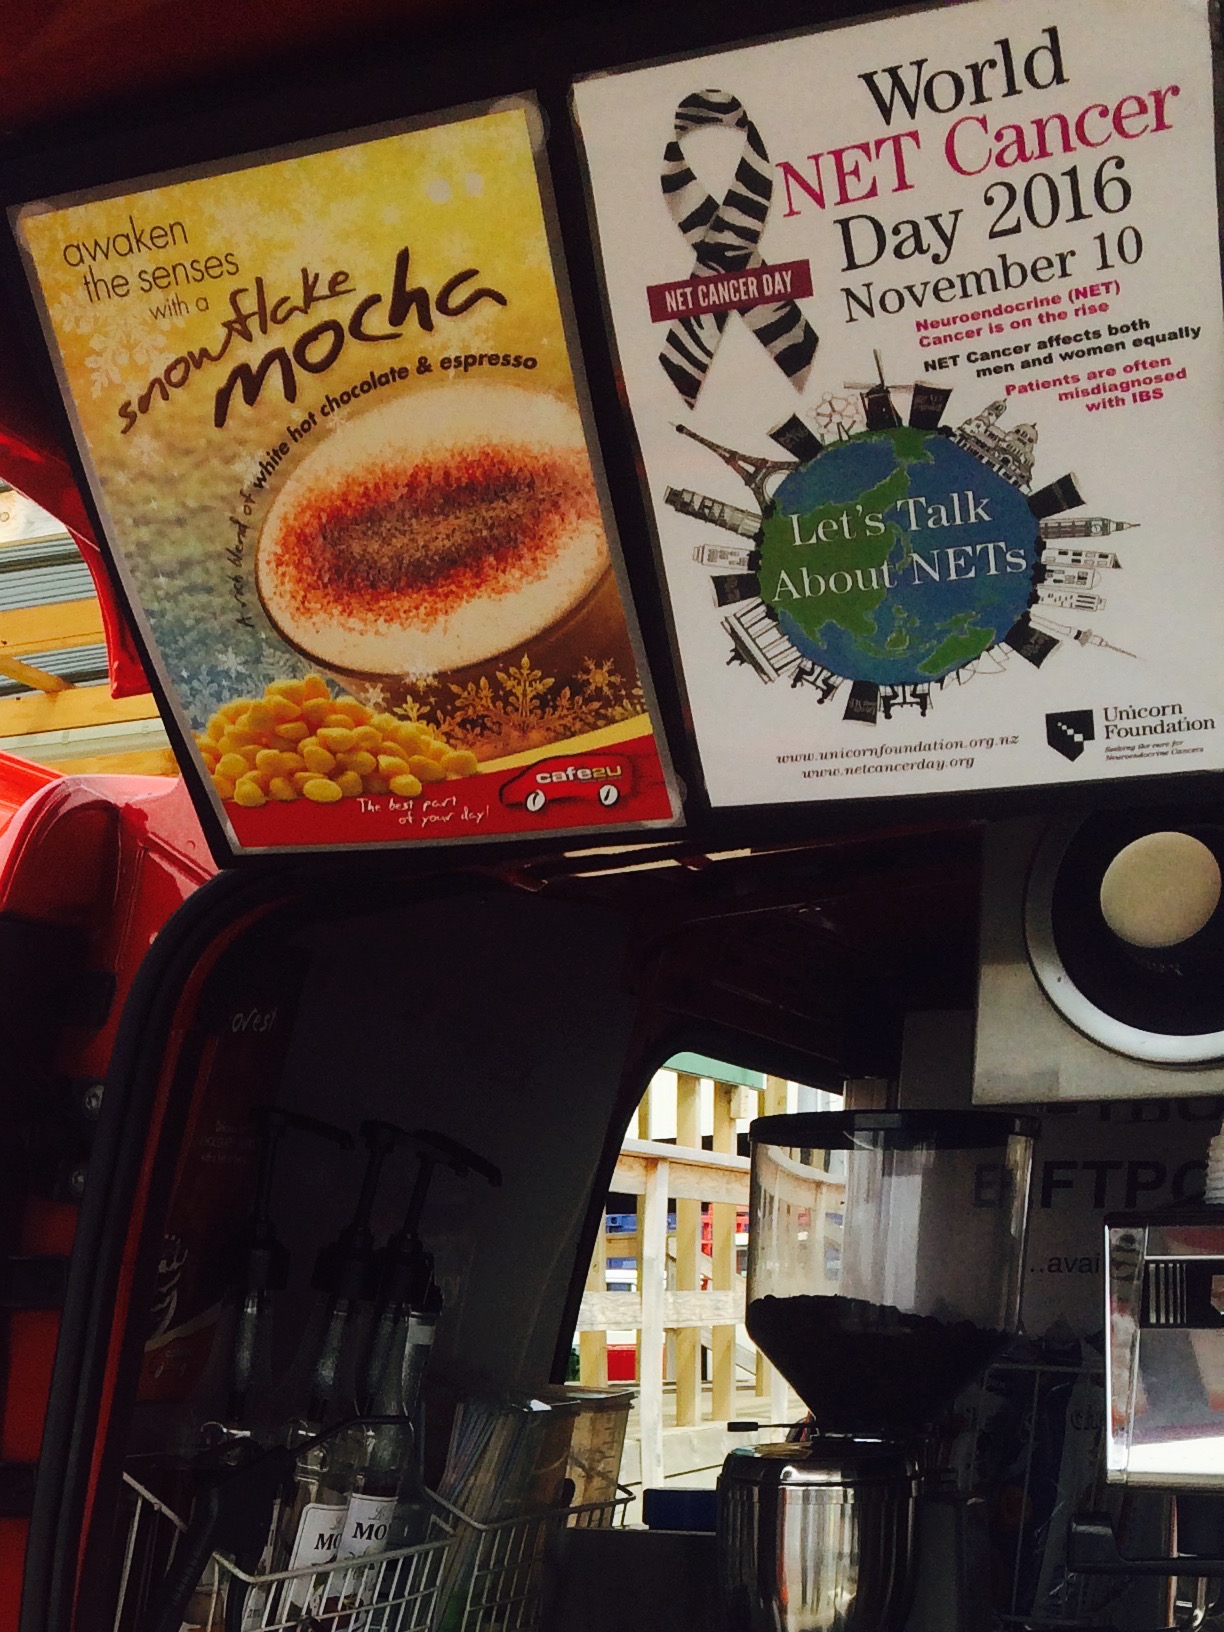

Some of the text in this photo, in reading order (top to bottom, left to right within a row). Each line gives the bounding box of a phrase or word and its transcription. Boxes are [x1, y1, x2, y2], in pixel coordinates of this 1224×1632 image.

[859, 26, 1069, 127] World
[776, 85, 1180, 217] NET Cancer
[834, 155, 1132, 272] Day 2016
[63, 215, 189, 267] awaken
[83, 252, 240, 303] the senses
[664, 270, 794, 314] NET CANCER DAY
[843, 226, 1143, 323] November 10
[148, 293, 210, 321] with a
[915, 279, 1121, 332] Neuroendocrine (NET)
[919, 301, 1110, 348] Cancer is on the rise
[924, 317, 1151, 372] NET Cancer affects both
[976, 326, 1202, 378] men and women equally
[1005, 356, 1172, 396] Patients are often
[1058, 367, 1187, 402] misdiagnosed
[1085, 387, 1164, 413] with IBS
[254, 441, 291, 491] white
[286, 411, 318, 443] hot
[320, 364, 410, 417] chocolate
[416, 356, 433, 375] &
[440, 352, 538, 373] espresso
[789, 491, 993, 547] Let's Talk
[772, 540, 1029, 602] About NETs
[1103, 703, 1183, 722] Unicorn
[1104, 716, 1216, 740] Foundation
[776, 734, 1020, 764] www.unicornfoundation.org.nz
[802, 757, 975, 779] www.netcancerday.org
[356, 796, 457, 813] The best part
[399, 811, 414, 826] of
[421, 813, 455, 828] your
